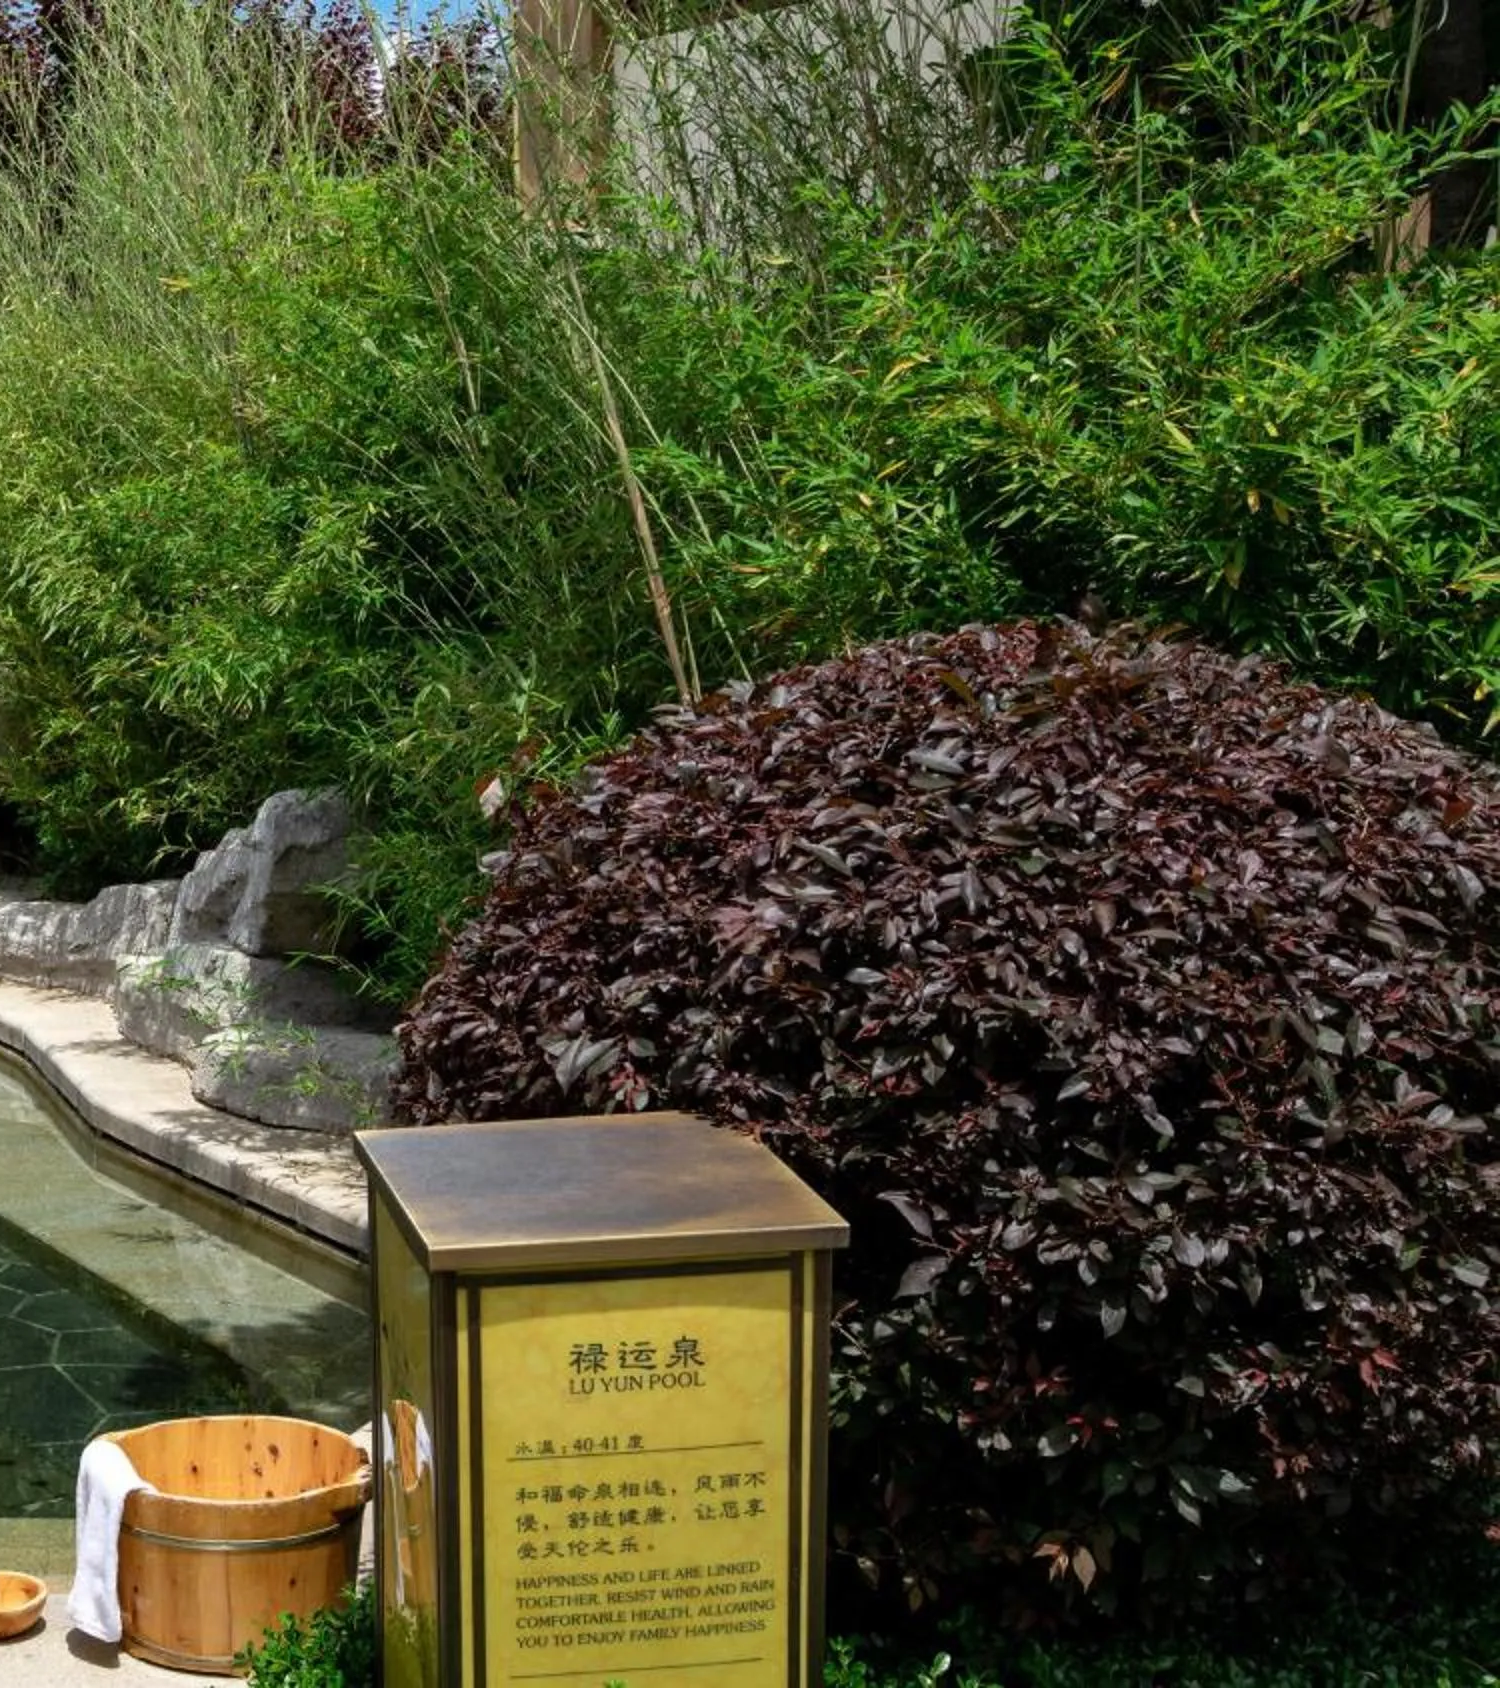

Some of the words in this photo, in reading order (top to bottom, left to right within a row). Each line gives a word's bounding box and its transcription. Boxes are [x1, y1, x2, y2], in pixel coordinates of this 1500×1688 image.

[568, 1335, 706, 1375] 禄运泉
[600, 1375, 643, 1393] YUN
[649, 1371, 706, 1391] POOL
[515, 1573, 599, 1590] HAPPINESS
[603, 1570, 635, 1585] AND
[639, 1568, 670, 1582] LIFE
[674, 1566, 702, 1579] ARE
[707, 1560, 761, 1577] LINKED
[606, 1589, 656, 1604] RESIST
[661, 1586, 701, 1600] WIND
[704, 1583, 737, 1597] AND
[516, 1611, 627, 1629] COMFORTABLE
[697, 1599, 775, 1617] ALLOWING
[516, 1635, 548, 1649] YOU
[552, 1634, 573, 1647] TO
[577, 1631, 624, 1645] ENJOY
[629, 1627, 679, 1643] FAMILY
[685, 1620, 766, 1638] HAPPINESS
